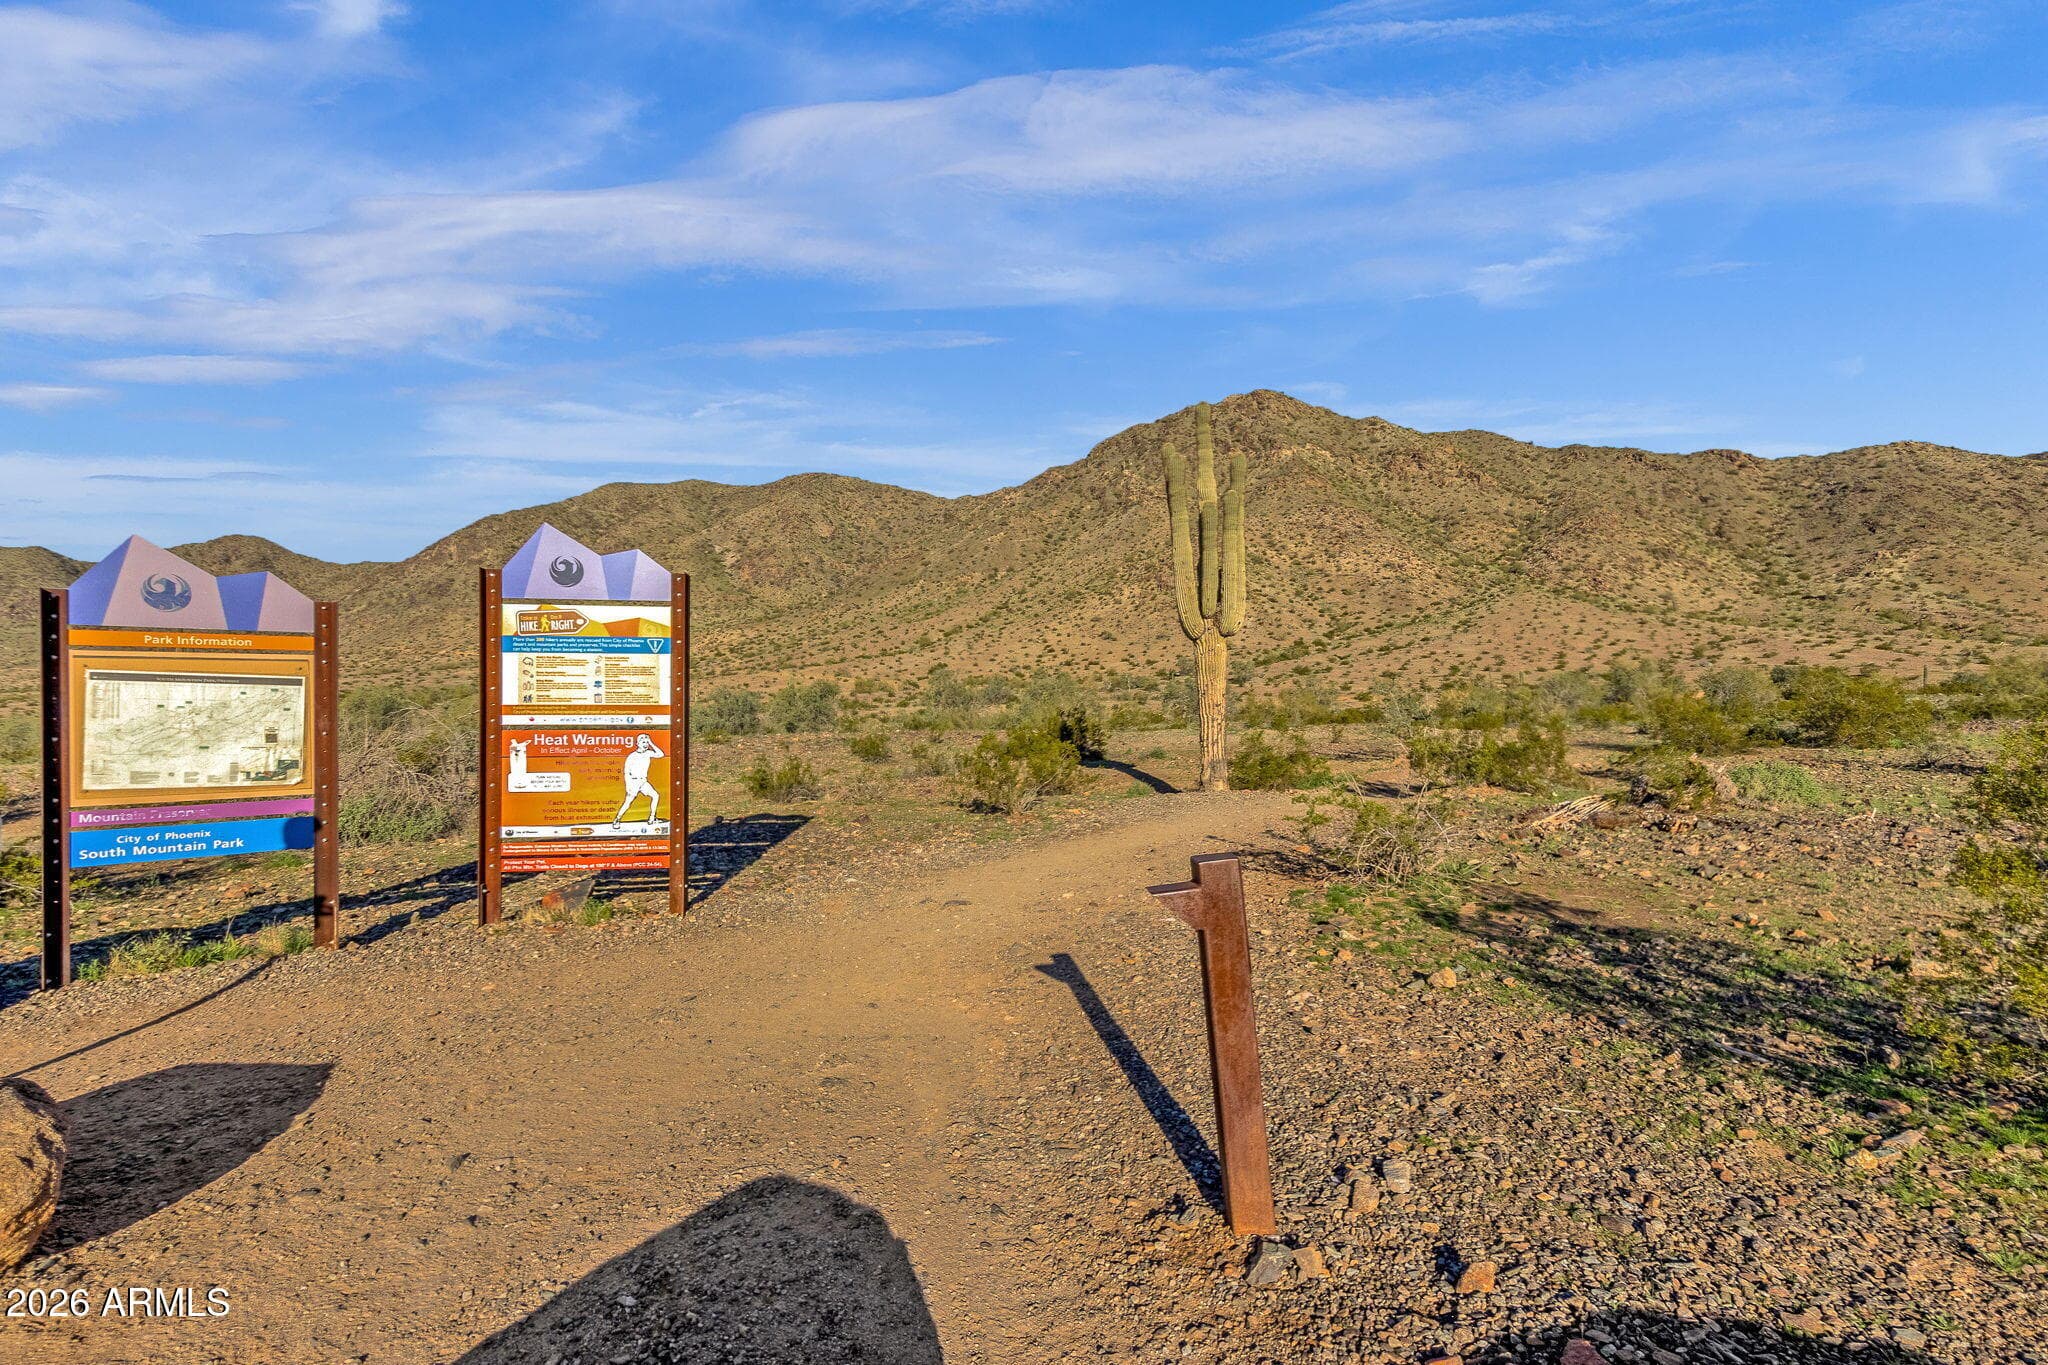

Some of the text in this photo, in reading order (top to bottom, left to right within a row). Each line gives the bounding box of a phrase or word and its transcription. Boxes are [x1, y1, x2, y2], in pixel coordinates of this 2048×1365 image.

[144, 635, 253, 647] Park Information
[534, 734, 634, 748] Heat Warning
[116, 830, 212, 844] City of Phoenix
[79, 838, 245, 860] South Mountain Park
